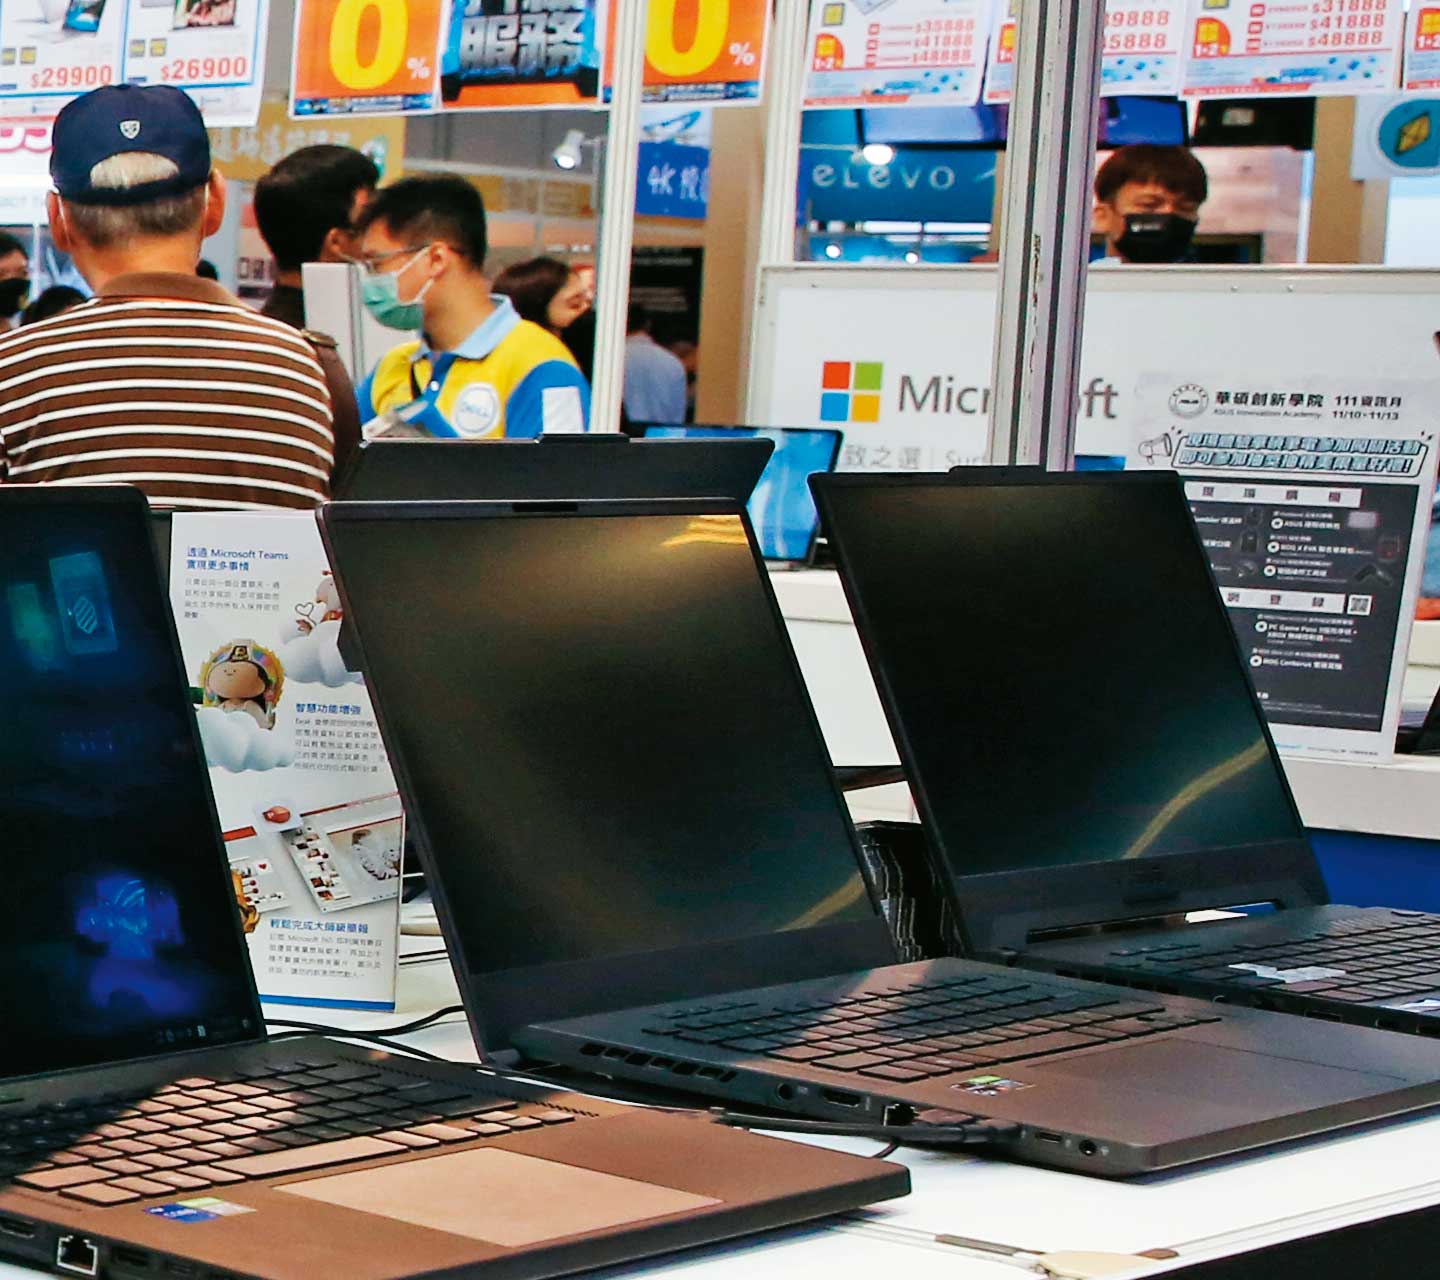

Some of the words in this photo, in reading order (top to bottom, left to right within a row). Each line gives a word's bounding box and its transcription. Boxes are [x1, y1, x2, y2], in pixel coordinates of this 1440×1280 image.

[1310, 14, 1384, 31] $41888
[1308, 31, 1383, 48] $48888
[730, 43, 756, 67] %
[30, 65, 112, 88] $29900
[161, 58, 248, 81] $26900
[407, 57, 430, 80] %
[1216, 391, 1323, 408] 華碩創新學院
[1335, 396, 1358, 407] 111
[211, 549, 257, 561] Microsoft
[258, 551, 289, 561] Teams
[295, 703, 361, 715] 智慧功能增強
